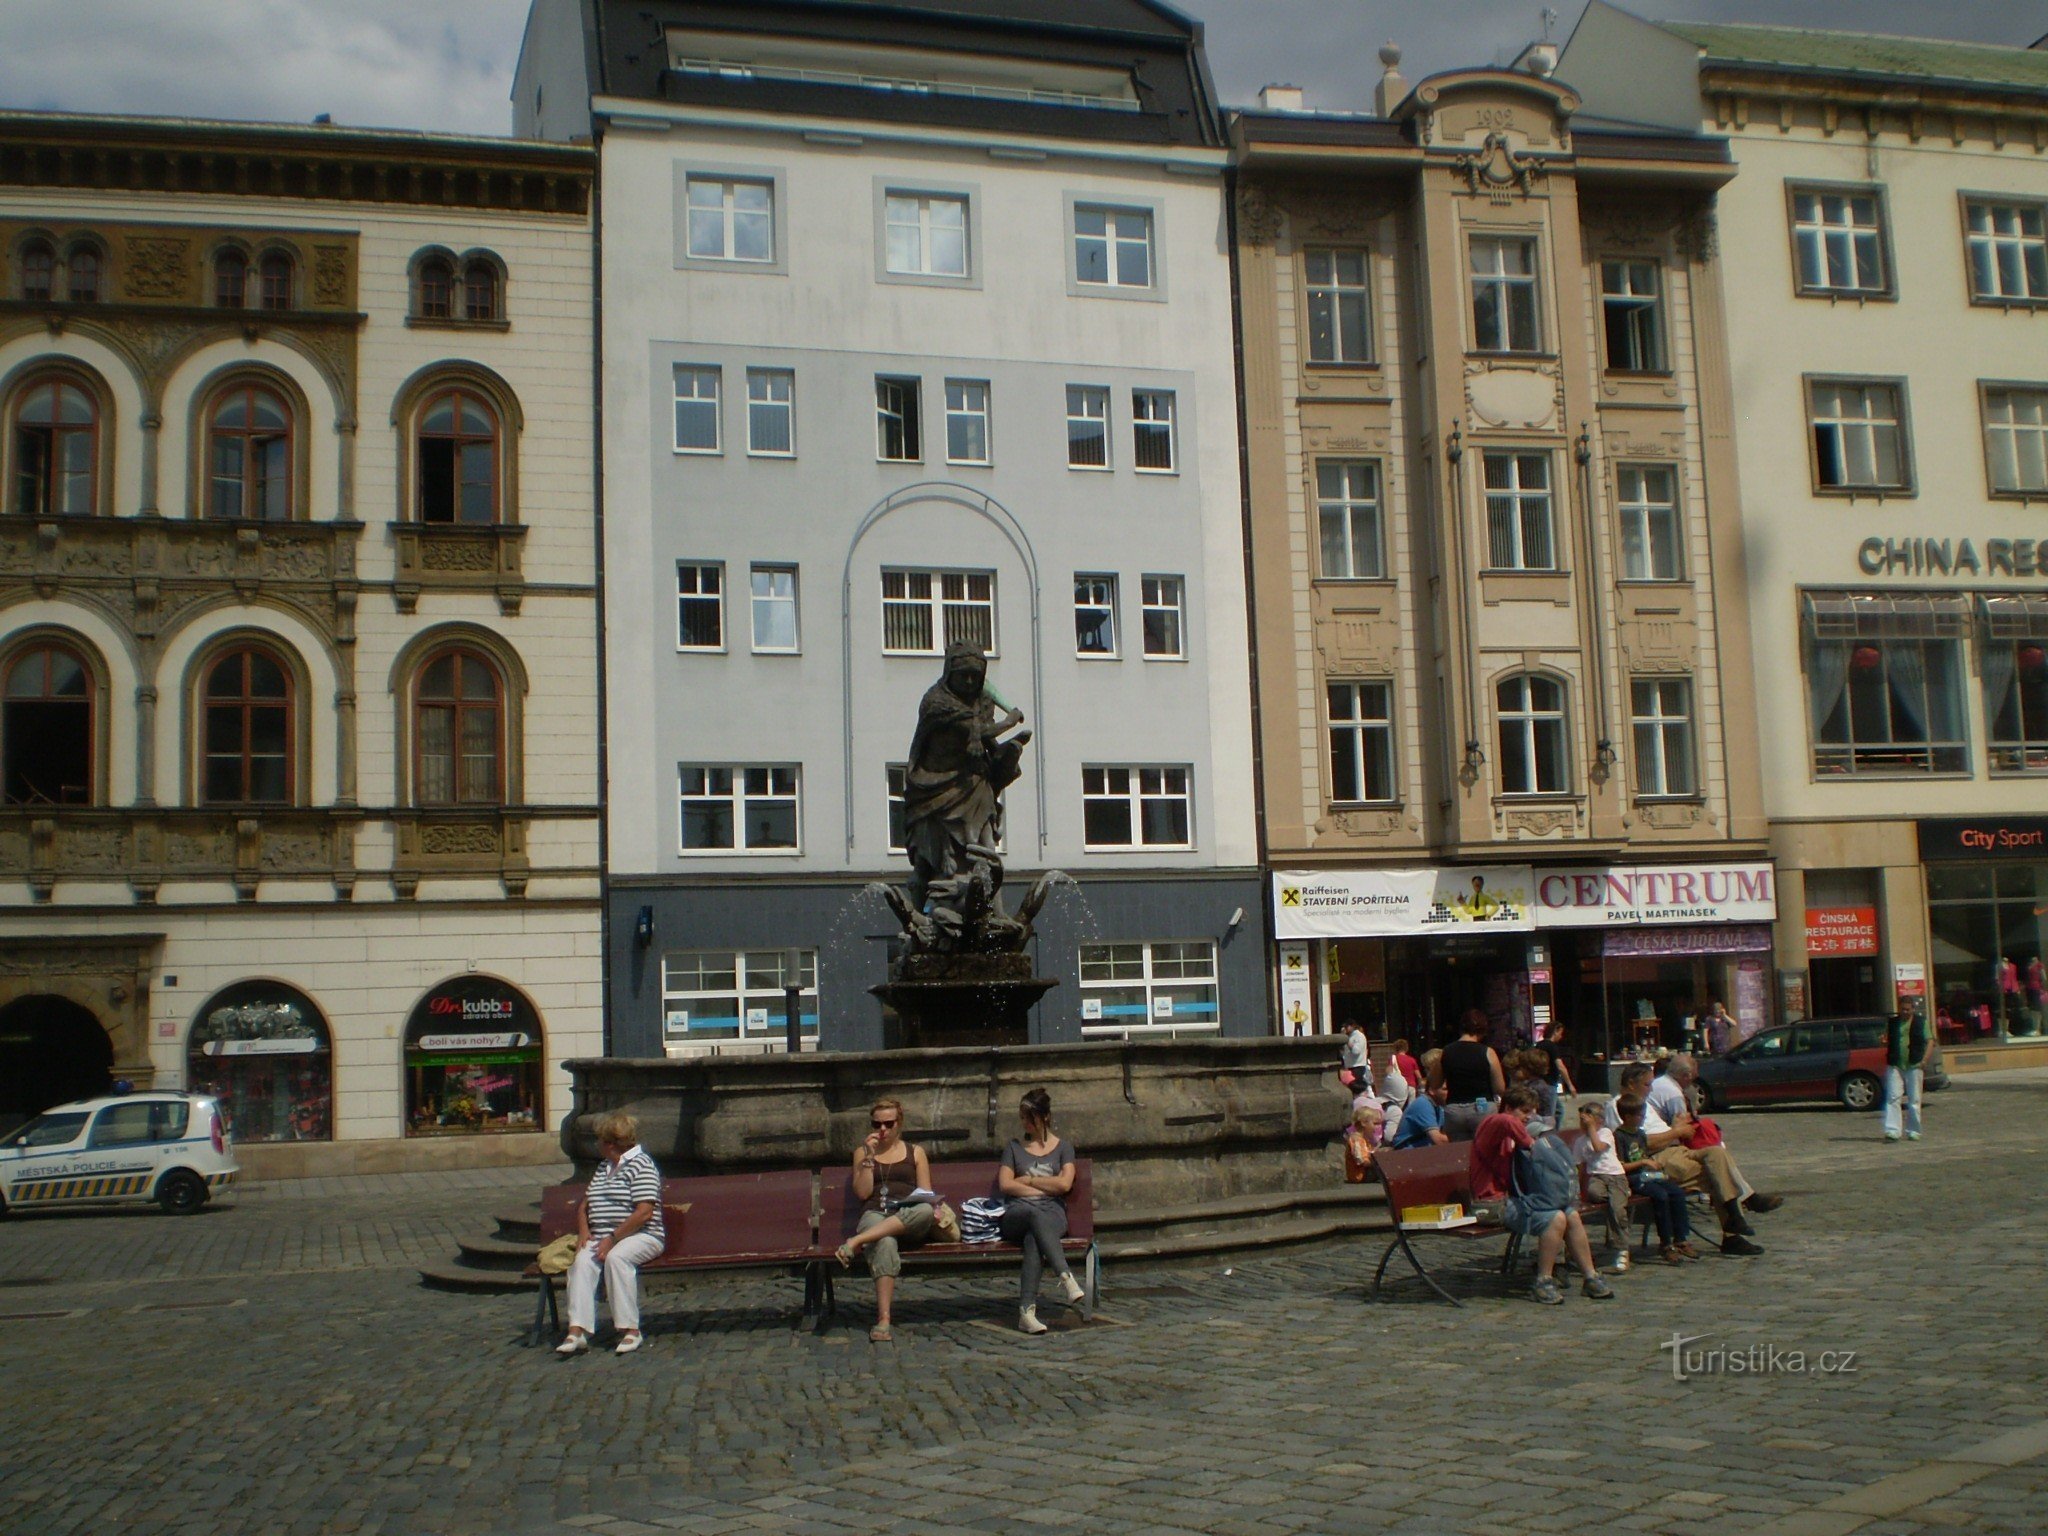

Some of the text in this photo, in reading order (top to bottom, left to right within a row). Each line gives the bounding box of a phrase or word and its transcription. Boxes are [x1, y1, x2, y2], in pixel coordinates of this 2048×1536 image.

[1476, 109, 1514, 127] 1902
[1858, 537, 1981, 577] CHINA
[1961, 828, 2043, 850] City Sport
[1302, 886, 1349, 895] Raiffeisen
[1539, 870, 1773, 908] CENTRUM
[1303, 895, 1410, 906] STAVEBNÍ SPOŘITELNA
[1607, 910, 1641, 920] PAVEL
[1805, 926, 1873, 936] RESTAURACE
[1634, 932, 1680, 949] ČESKÁ
[73, 1161, 117, 1172] POLICIE
